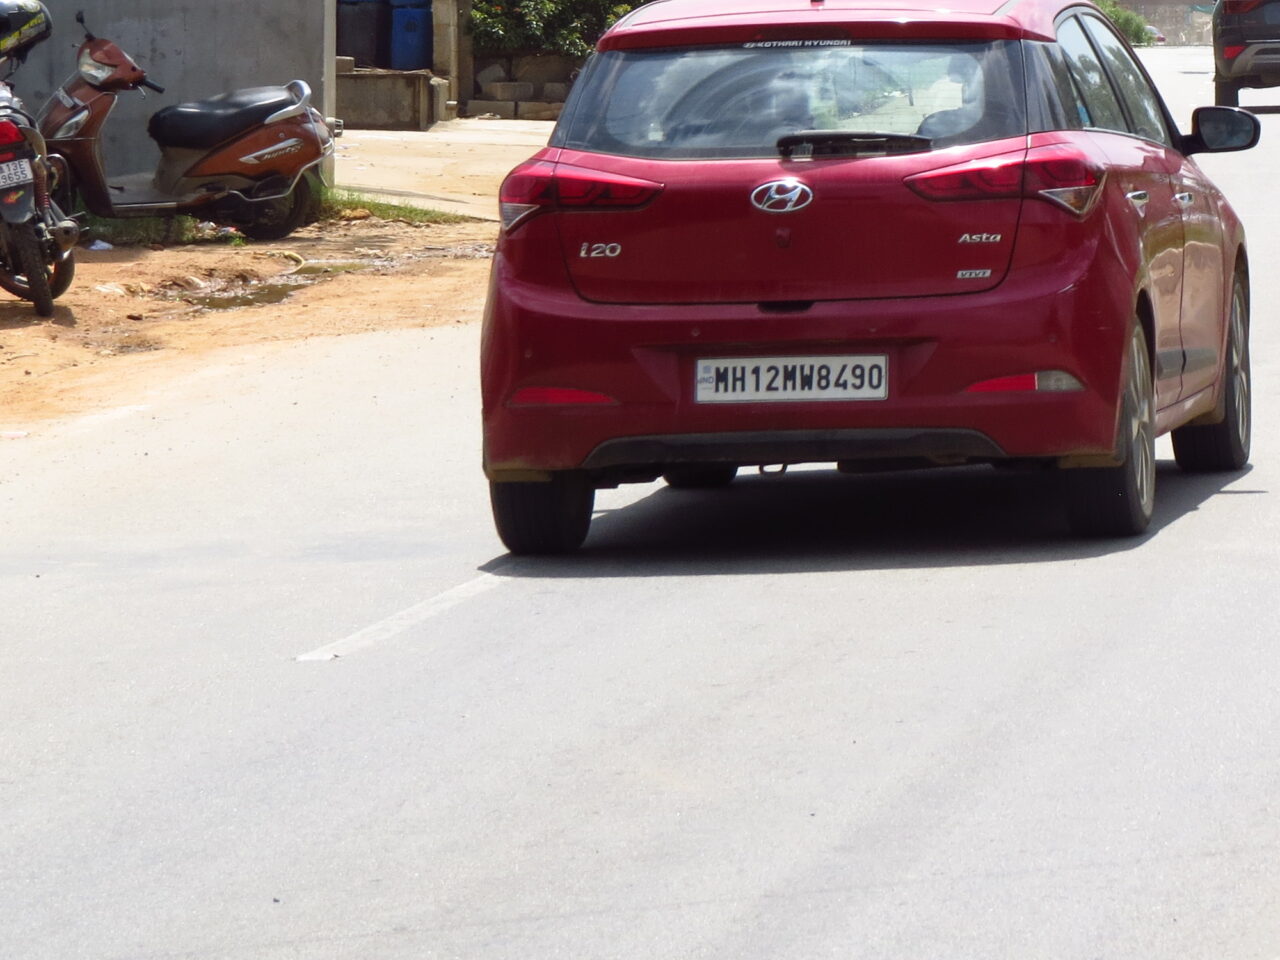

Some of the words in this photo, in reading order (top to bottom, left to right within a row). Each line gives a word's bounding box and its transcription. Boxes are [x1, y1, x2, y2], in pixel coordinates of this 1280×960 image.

[756, 40, 803, 48] KOTHARI
[804, 39, 852, 47] HYUNDAI
[957, 233, 1002, 243] Asta
[578, 242, 622, 258] i20
[714, 363, 883, 393] MH12MW8490
